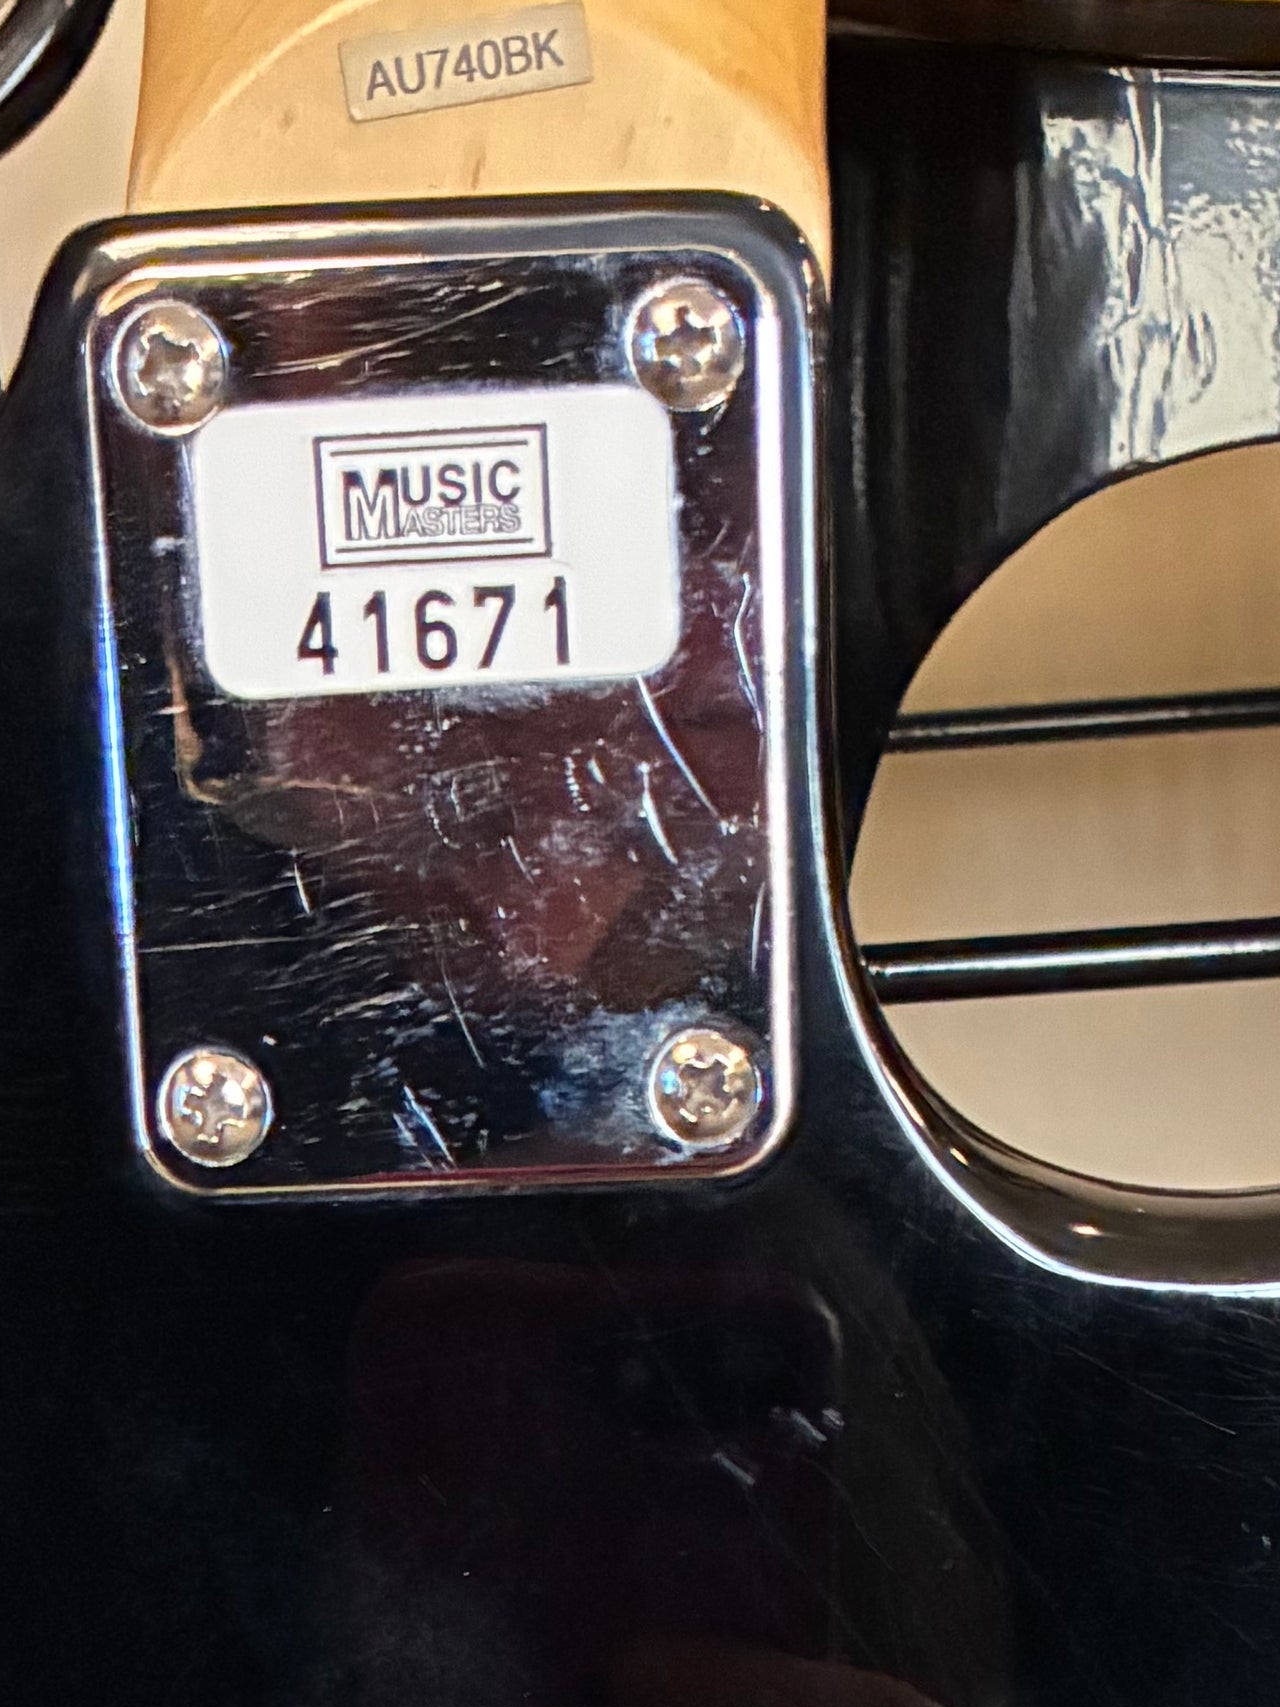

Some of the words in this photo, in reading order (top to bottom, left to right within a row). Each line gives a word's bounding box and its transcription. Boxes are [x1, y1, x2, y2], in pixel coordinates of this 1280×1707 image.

[366, 28, 564, 101] AU740BK
[342, 459, 521, 541] MUSIC
[298, 575, 570, 675] 41671
